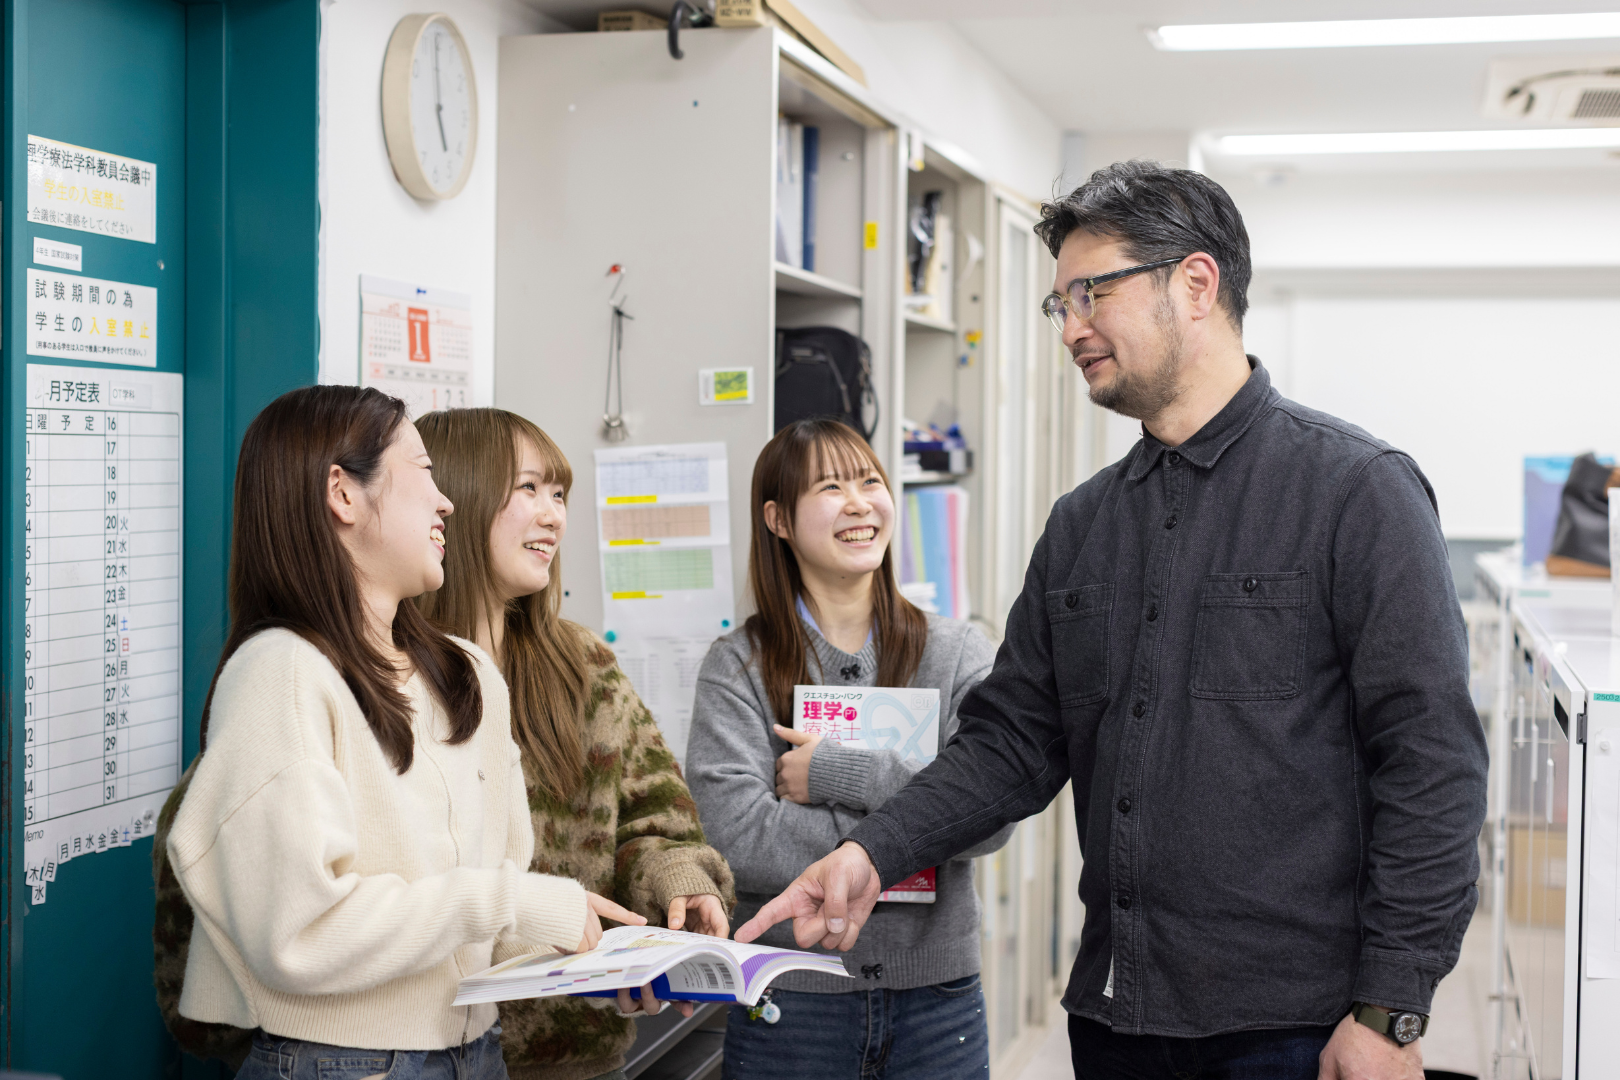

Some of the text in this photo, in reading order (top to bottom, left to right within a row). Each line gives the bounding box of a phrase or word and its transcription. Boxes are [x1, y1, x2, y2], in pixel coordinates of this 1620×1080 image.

[44, 179, 125, 211] 学生の入室禁止
[35, 279, 133, 309] 試験期間の為
[50, 380, 100, 403] 月予定表
[37, 413, 47, 430] 曜
[107, 416, 117, 431] 16
[26, 440, 30, 455] 1
[107, 441, 116, 455] 17
[26, 466, 32, 481] 2
[107, 466, 116, 480] 18
[25, 493, 32, 507] 3
[107, 490, 117, 505] 19
[25, 519, 32, 533] 4
[105, 515, 129, 531] 20 火
[25, 545, 32, 560] 5
[106, 538, 128, 554] 21 水
[25, 571, 32, 586] 6
[105, 564, 128, 579] 22 木
[105, 585, 126, 604] 23 金
[25, 597, 32, 612] 7
[105, 614, 129, 632] 24 土
[25, 624, 32, 638] 8
[105, 637, 130, 652] 25 日
[25, 650, 32, 664] 9
[105, 660, 128, 677] 26 月
[105, 683, 130, 702] 27 火
[105, 708, 130, 726] 28 水
[803, 701, 843, 721] 理学
[105, 736, 116, 751] 29
[104, 760, 116, 776] 30
[106, 785, 115, 800] 31
[60, 819, 143, 860] 月 月 水 金 金 土 金
[29, 861, 55, 882] 木 月
[34, 884, 45, 901] 水
